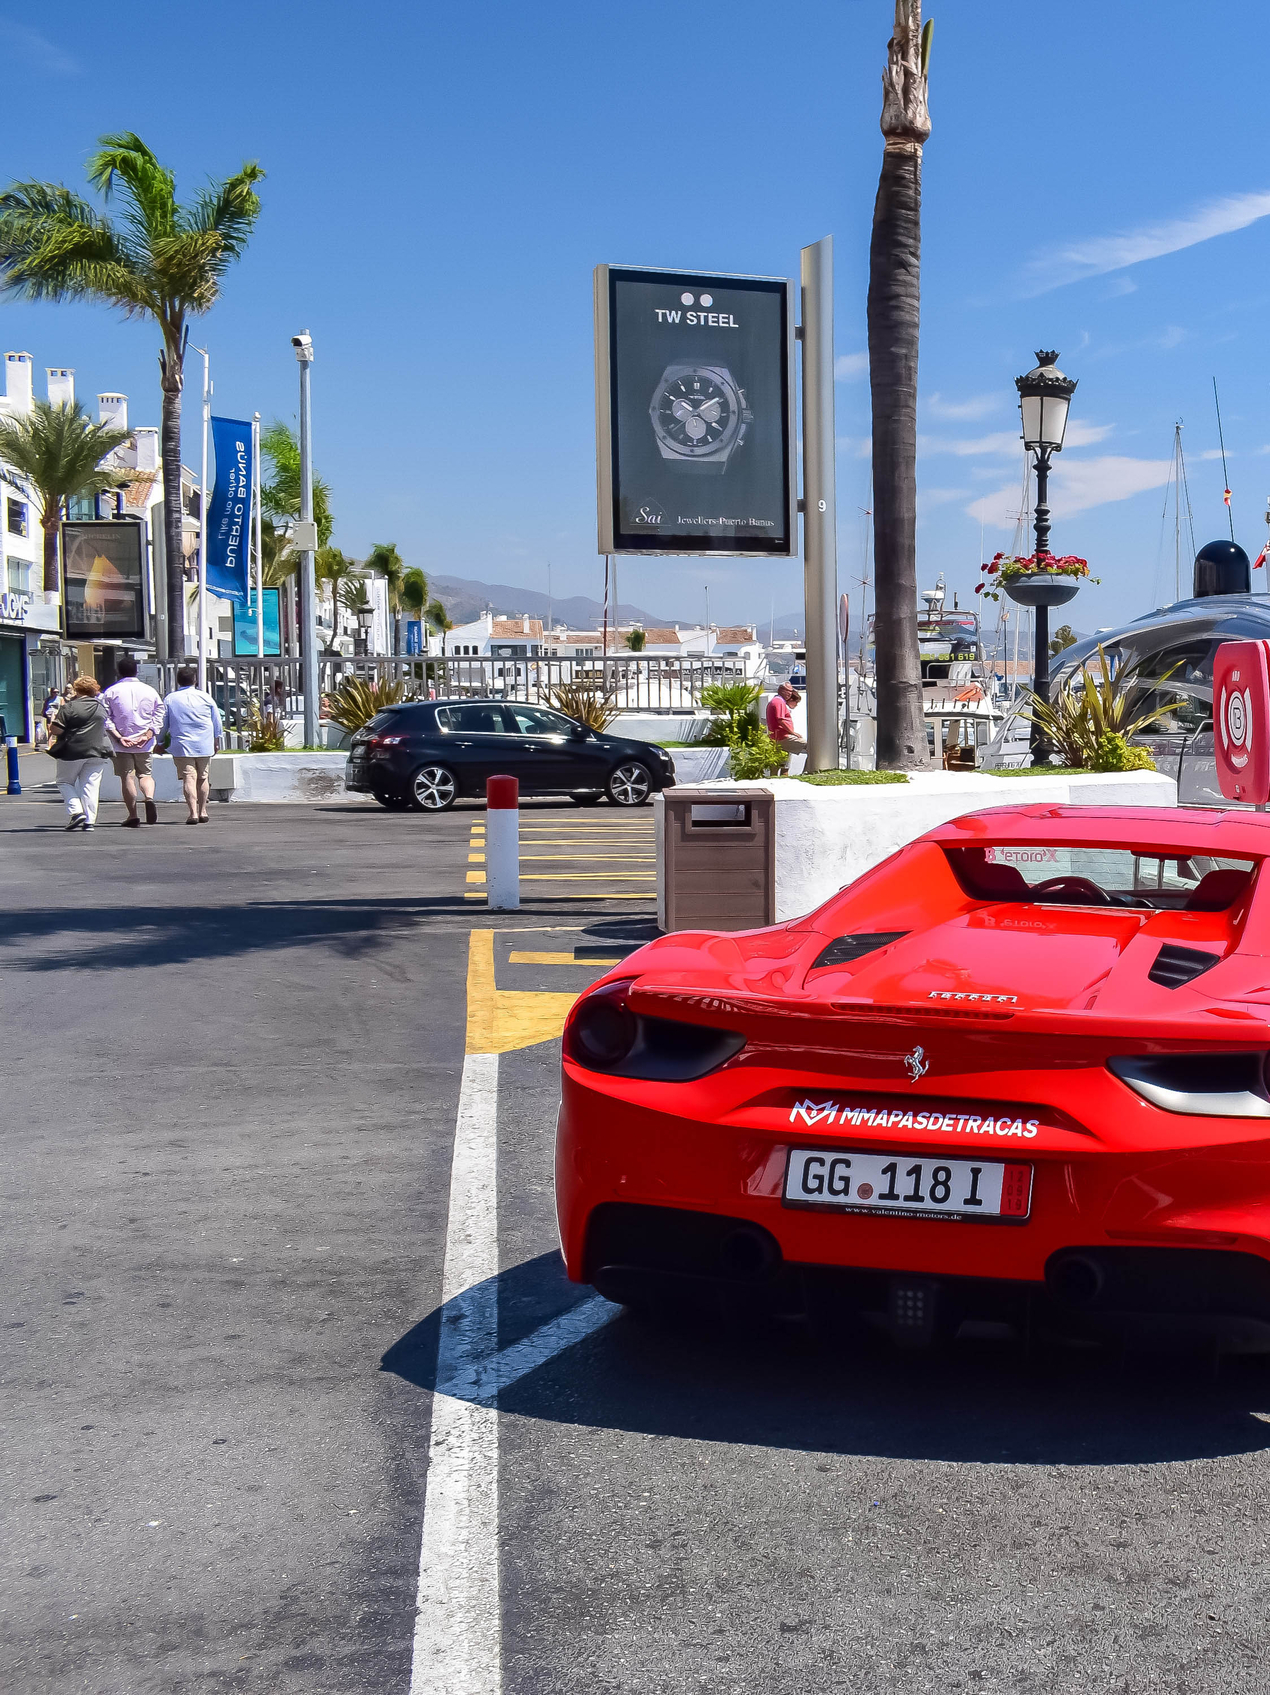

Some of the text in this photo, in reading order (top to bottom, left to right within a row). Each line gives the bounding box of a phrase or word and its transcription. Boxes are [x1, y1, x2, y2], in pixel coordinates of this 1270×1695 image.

[655, 309, 739, 328] TW STEEL
[818, 499, 827, 512] 9
[635, 506, 663, 524] Sai
[958, 653, 975, 661] 619
[839, 1107, 1040, 1139] MMAPASDETRACAS
[801, 1156, 852, 1197] GG
[877, 1161, 952, 1204] 118
[845, 1207, 962, 1220] www.valentino-motors.de
